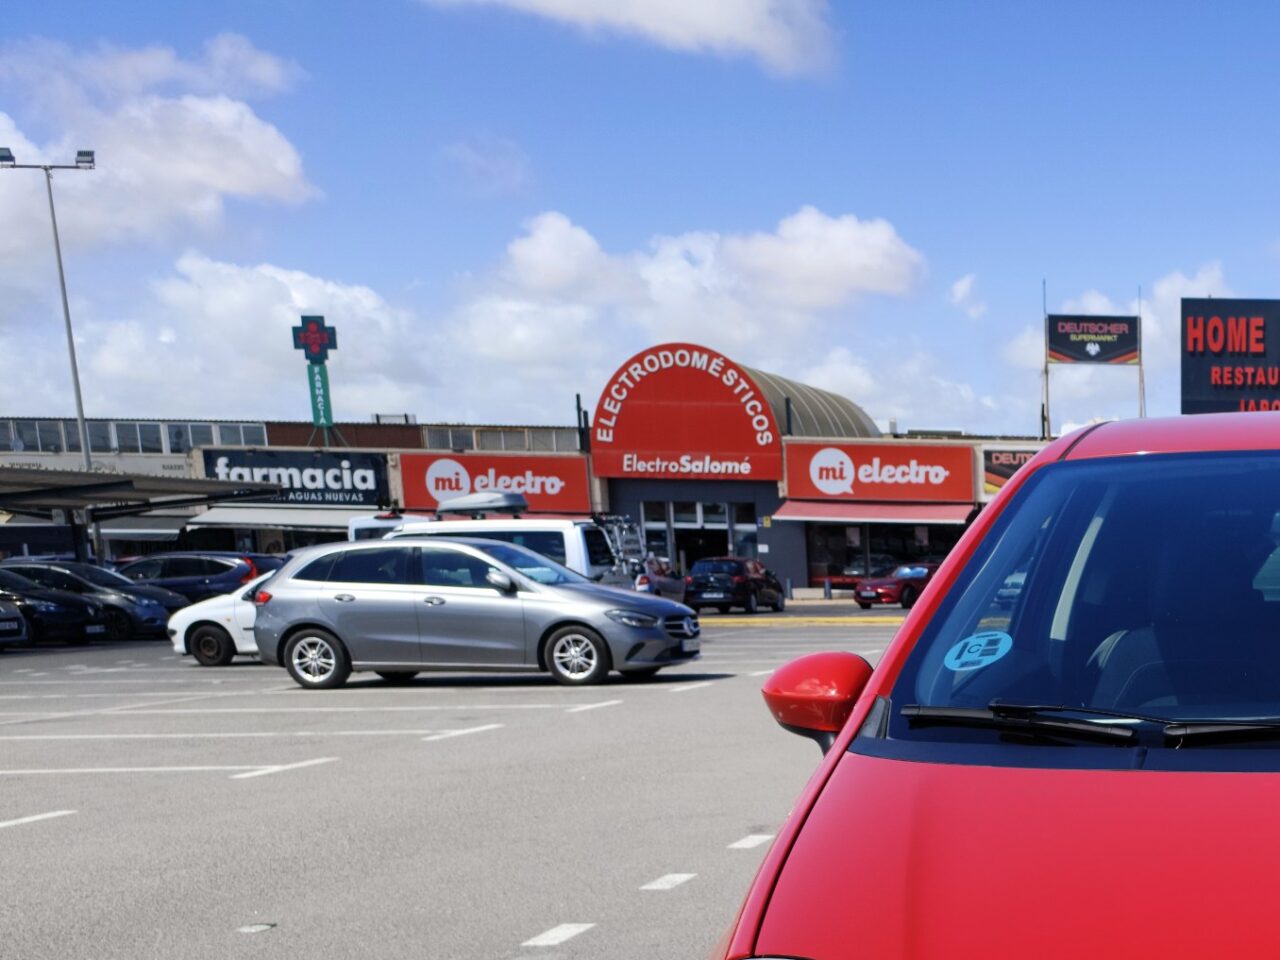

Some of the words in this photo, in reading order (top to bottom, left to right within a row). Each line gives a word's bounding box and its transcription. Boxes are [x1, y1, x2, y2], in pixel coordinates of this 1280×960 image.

[1058, 322, 1128, 334] DEUTSCHER
[1069, 334, 1118, 342] SUPERMARKT
[1186, 316, 1265, 352] HOME
[313, 365, 328, 425] FARMACIA
[597, 349, 773, 446] ELECTRODOMÉSTICOS
[215, 456, 376, 490] farmacia
[435, 472, 463, 491] mi
[474, 468, 565, 495] electro
[818, 461, 847, 481] mi
[858, 457, 950, 485] electro
[289, 491, 322, 501] AGUAS
[325, 492, 364, 502] NUEVAS
